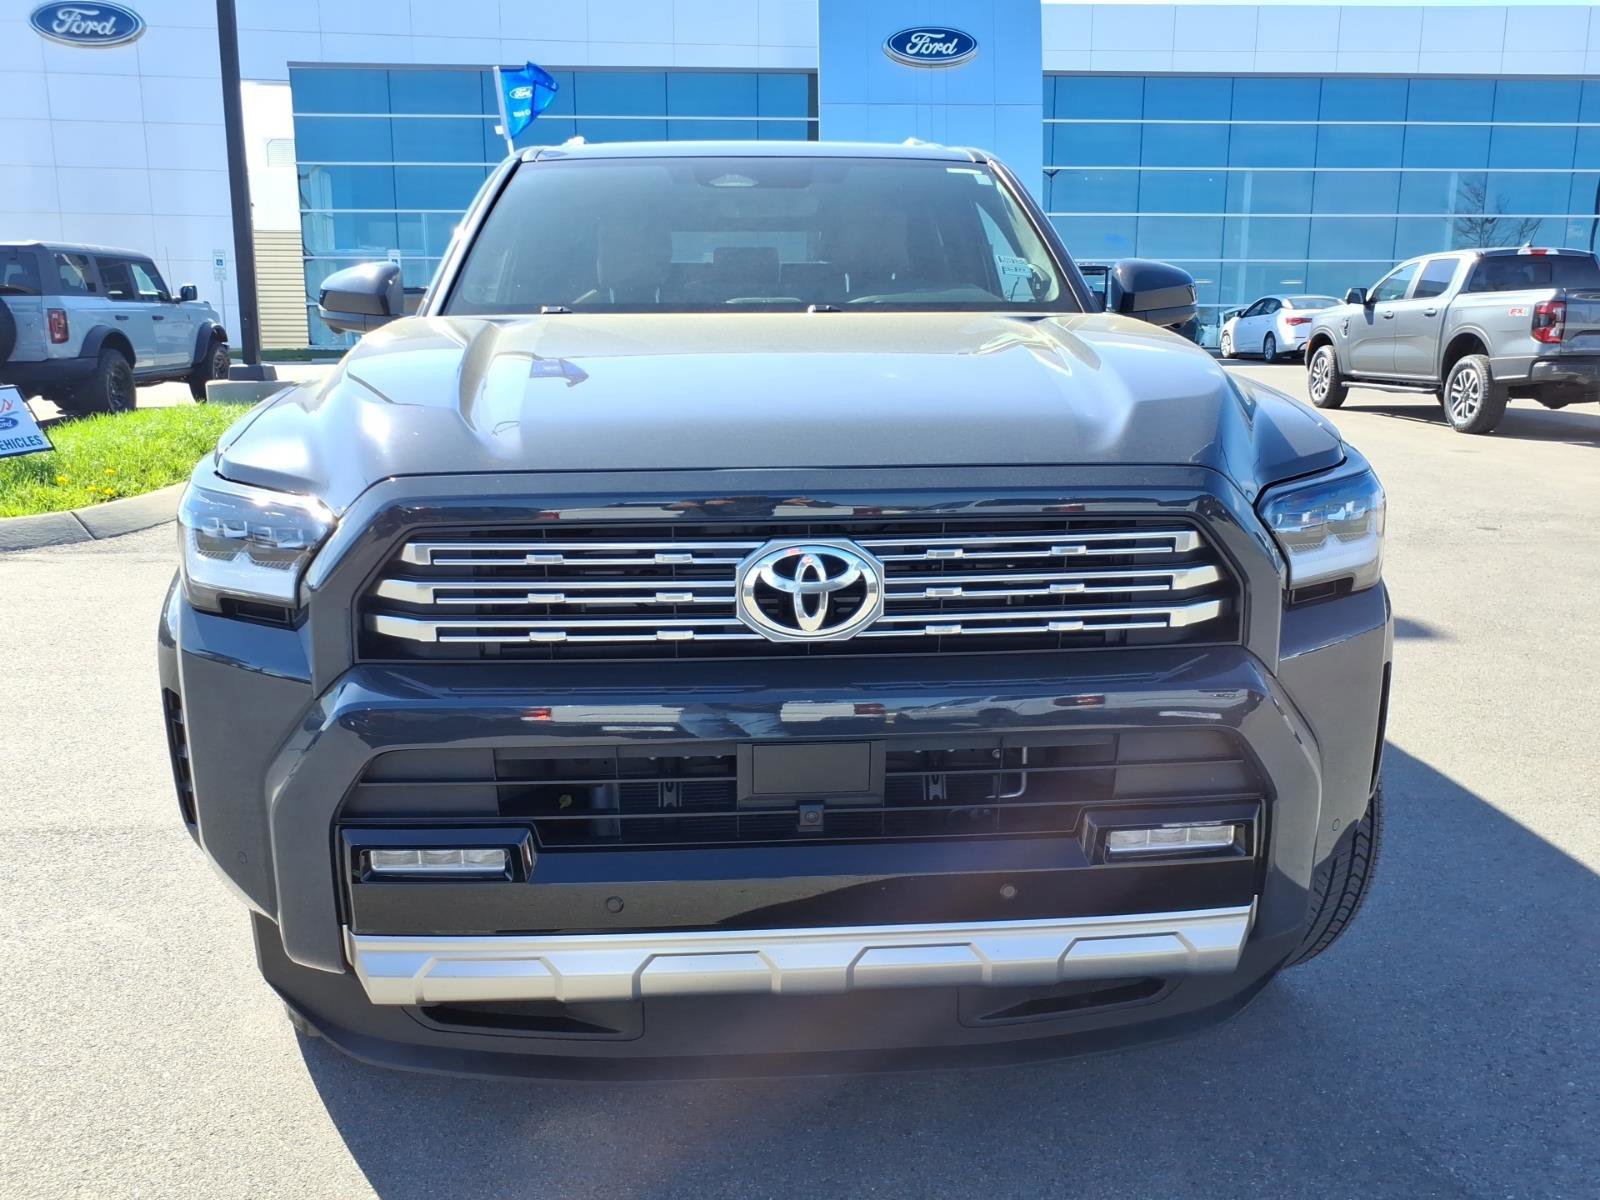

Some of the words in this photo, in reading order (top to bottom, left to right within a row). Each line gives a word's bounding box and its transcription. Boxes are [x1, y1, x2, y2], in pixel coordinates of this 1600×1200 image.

[52, 7, 117, 35] Ford
[905, 32, 959, 55] Ford
[0, 434, 44, 451] EHICLES
